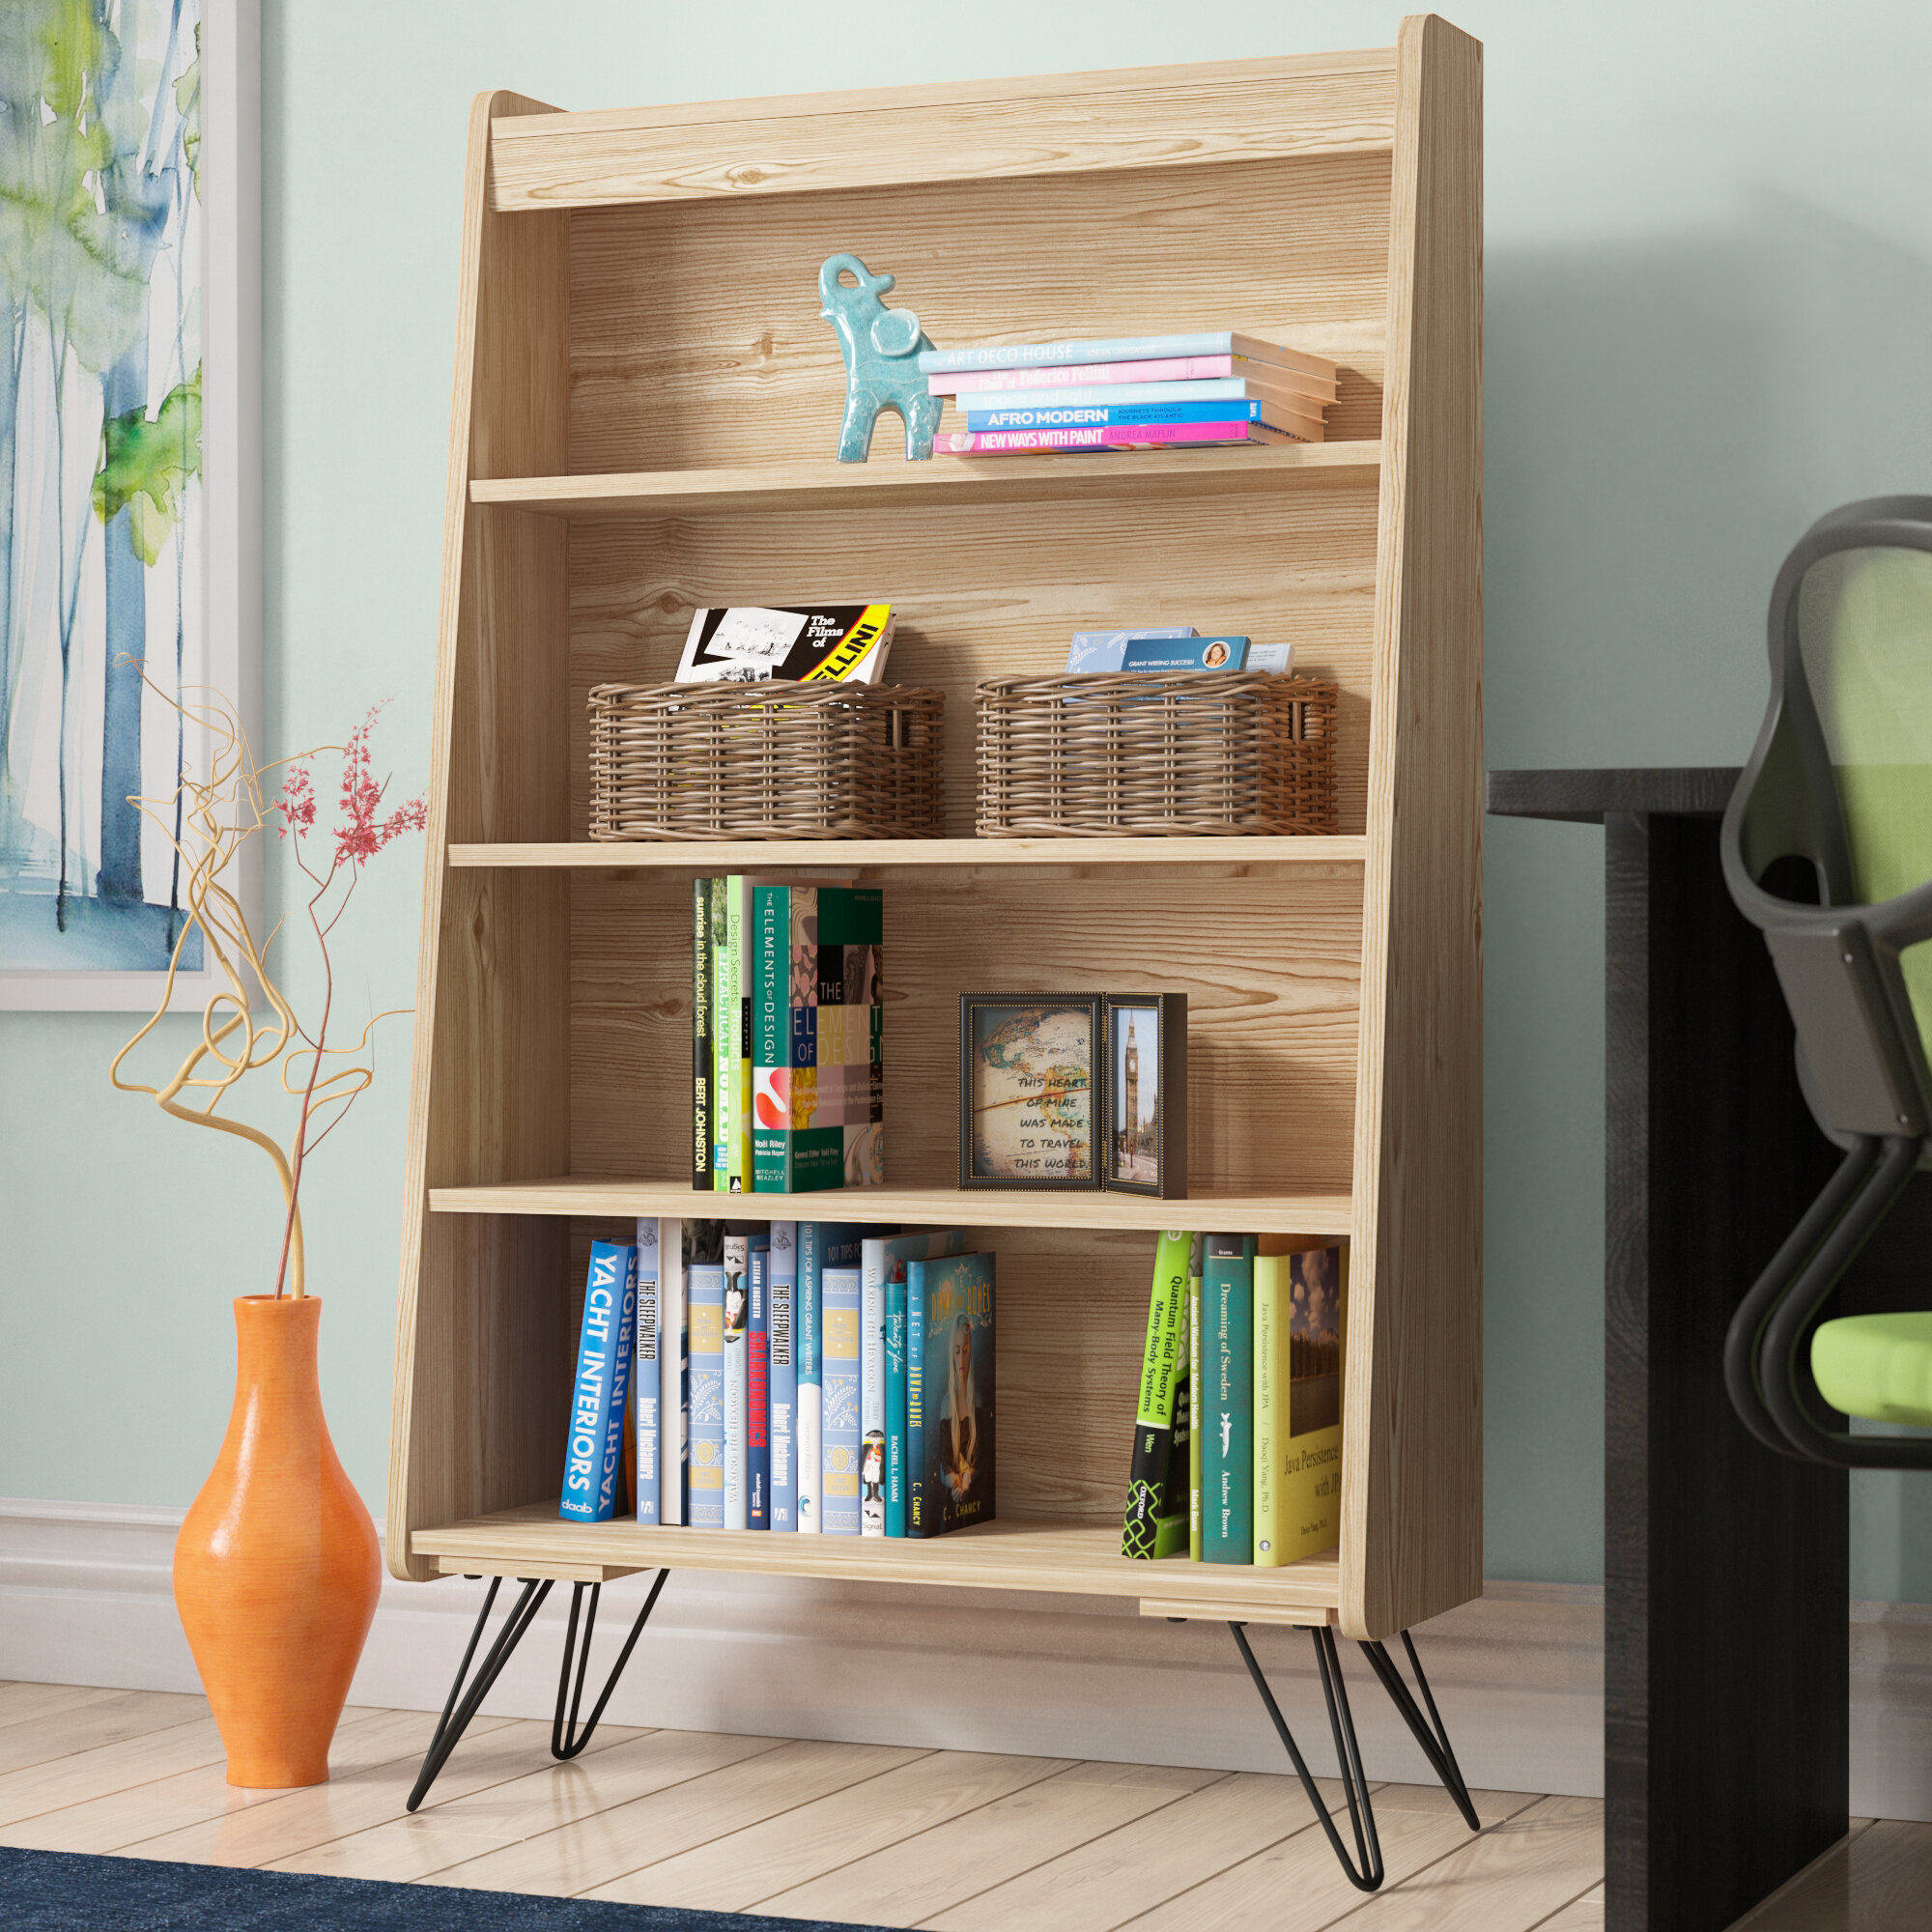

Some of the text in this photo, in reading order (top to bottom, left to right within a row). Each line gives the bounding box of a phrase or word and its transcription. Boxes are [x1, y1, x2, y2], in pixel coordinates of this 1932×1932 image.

[947, 350, 975, 366] ART
[978, 348, 1018, 364] DECO
[1023, 344, 1074, 360] HOUSE
[1019, 364, 1110, 385] Federico Fellini
[982, 388, 1094, 408] space and light
[987, 409, 1109, 426] AFRO MODERN
[980, 429, 1103, 449] NEW WAYS WITH PAINT
[1108, 430, 1143, 440] ANDREA
[811, 615, 836, 626] The
[807, 626, 844, 638] Films
[812, 637, 827, 647] of
[765, 909, 776, 989] ELEMENTS
[696, 896, 706, 1037] sunrise in the cloud forest
[728, 914, 742, 1071] Design Secrets: Products
[767, 989, 773, 1001] OF
[820, 981, 841, 1001] THE
[765, 1002, 776, 1065] DESIGN
[798, 1042, 815, 1063] OF
[1018, 1078, 1089, 1088] THIS HEART
[1027, 1098, 1078, 1108] OF MINE
[695, 1076, 706, 1172] BERT JOHNSTON
[1020, 1119, 1084, 1128] WAS MADE
[1020, 1139, 1083, 1149] TO TRAVEL
[1014, 1158, 1040, 1169] THIS
[828, 1243, 854, 1262] 101 TIPS
[753, 1260, 761, 1285] STEFAN
[867, 1266, 876, 1315] WALKING
[639, 1280, 656, 1360] THE SLEEPWALKER
[772, 1284, 790, 1366] THE SLEEPWALKER
[867, 1320, 876, 1338] THE
[911, 1311, 922, 1338] NET
[912, 1347, 918, 1359] OF
[1155, 1275, 1183, 1416] Quantum Field Theory of
[1218, 1283, 1232, 1401] Dreaming of Sweden
[1143, 1300, 1163, 1412] Many-Body Systems
[568, 1254, 618, 1492] YACHT INTERIORS
[867, 1343, 876, 1393] HEXAGON
[598, 1255, 638, 1514] YACHT INTERIORS
[749, 1330, 766, 1447] SHARKONOMICS
[639, 1397, 657, 1427] Robert
[773, 1403, 791, 1433] Robert
[728, 1380, 738, 1504] WALKING THE HEXAGON
[1144, 1434, 1155, 1453] Wen
[1260, 1437, 1269, 1463] Daoqi
[1284, 1444, 1339, 1476] Java Persistence
[913, 1481, 922, 1492] C.
[1314, 1476, 1329, 1498] with
[561, 1498, 593, 1514] daab
[943, 1506, 951, 1521] C.
[1137, 1486, 1148, 1520] OXFORD
[1222, 1469, 1231, 1538] Andrew Brown
